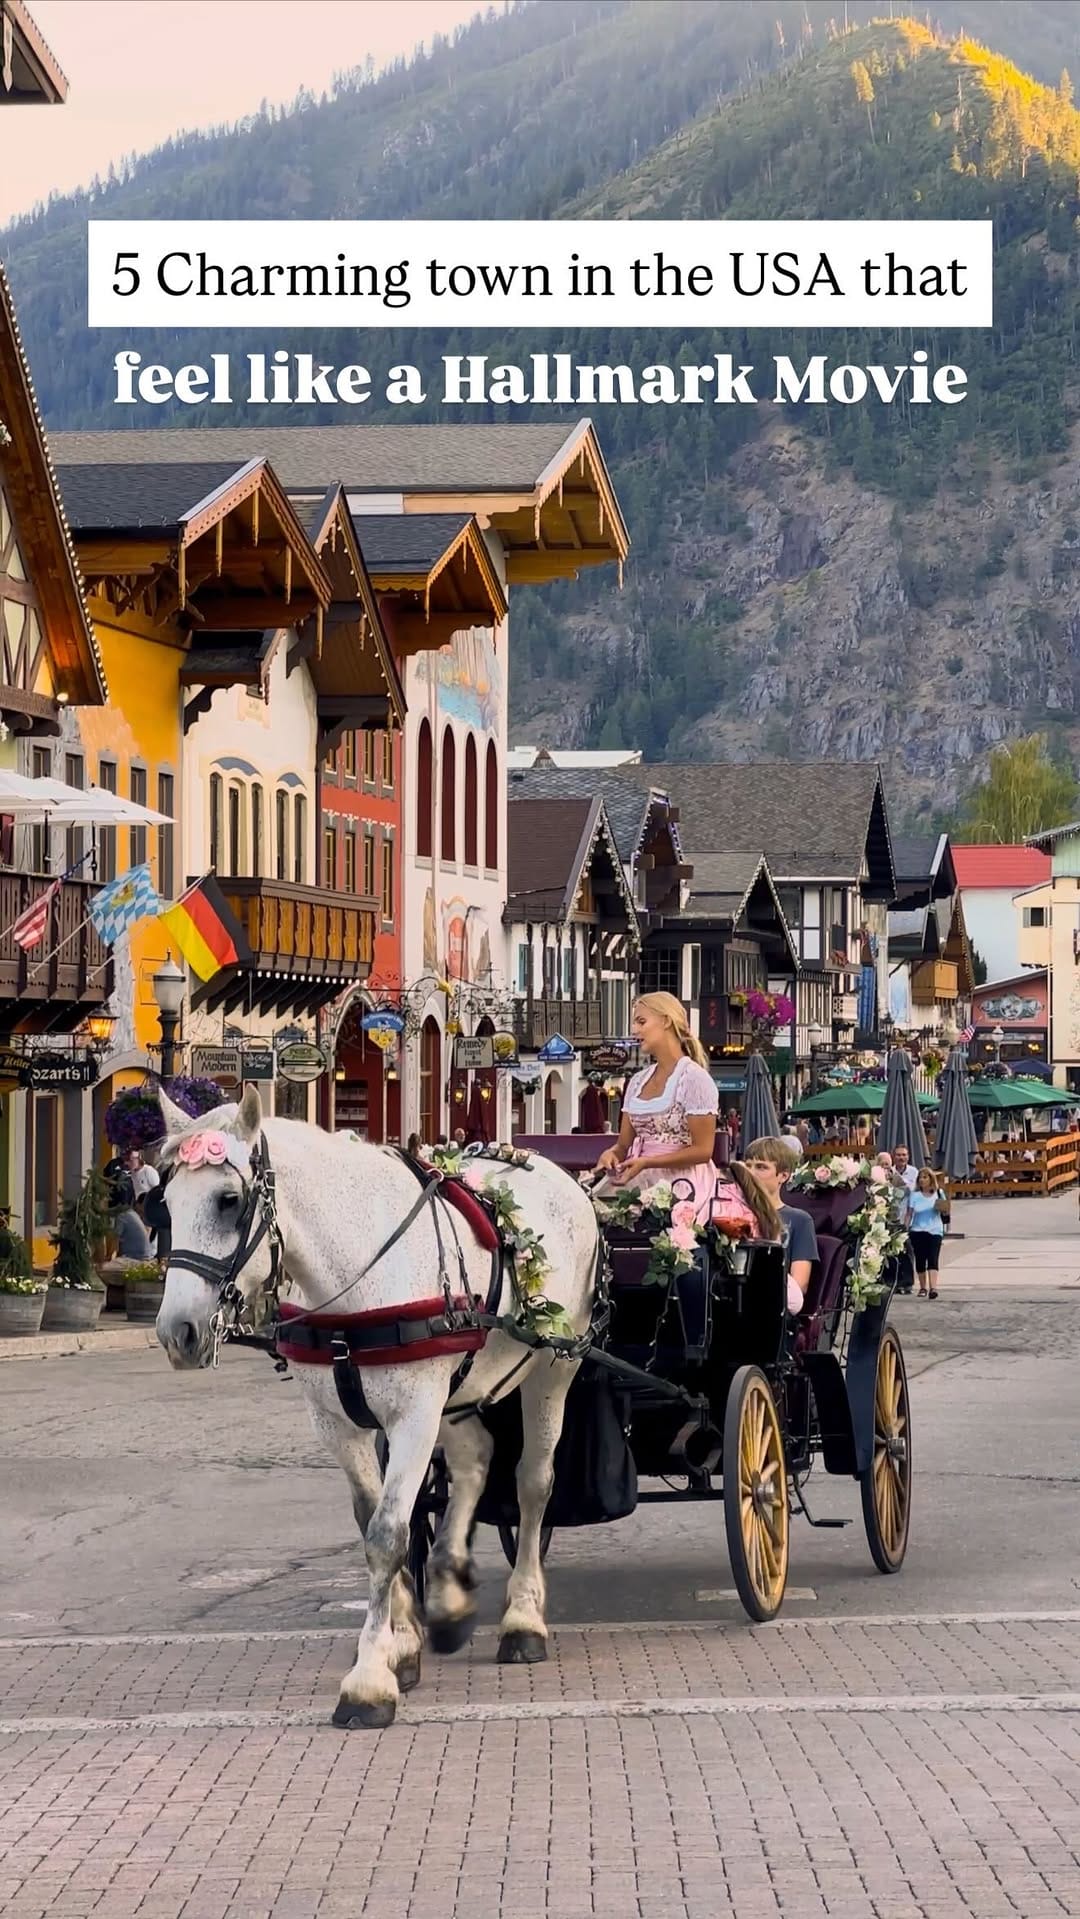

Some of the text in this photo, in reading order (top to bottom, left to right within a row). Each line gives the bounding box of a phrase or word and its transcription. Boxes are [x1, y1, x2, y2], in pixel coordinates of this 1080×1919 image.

[197, 1050, 237, 1062] Mountain
[32, 1065, 81, 1080] ozart's
[201, 1061, 236, 1072] Modern
